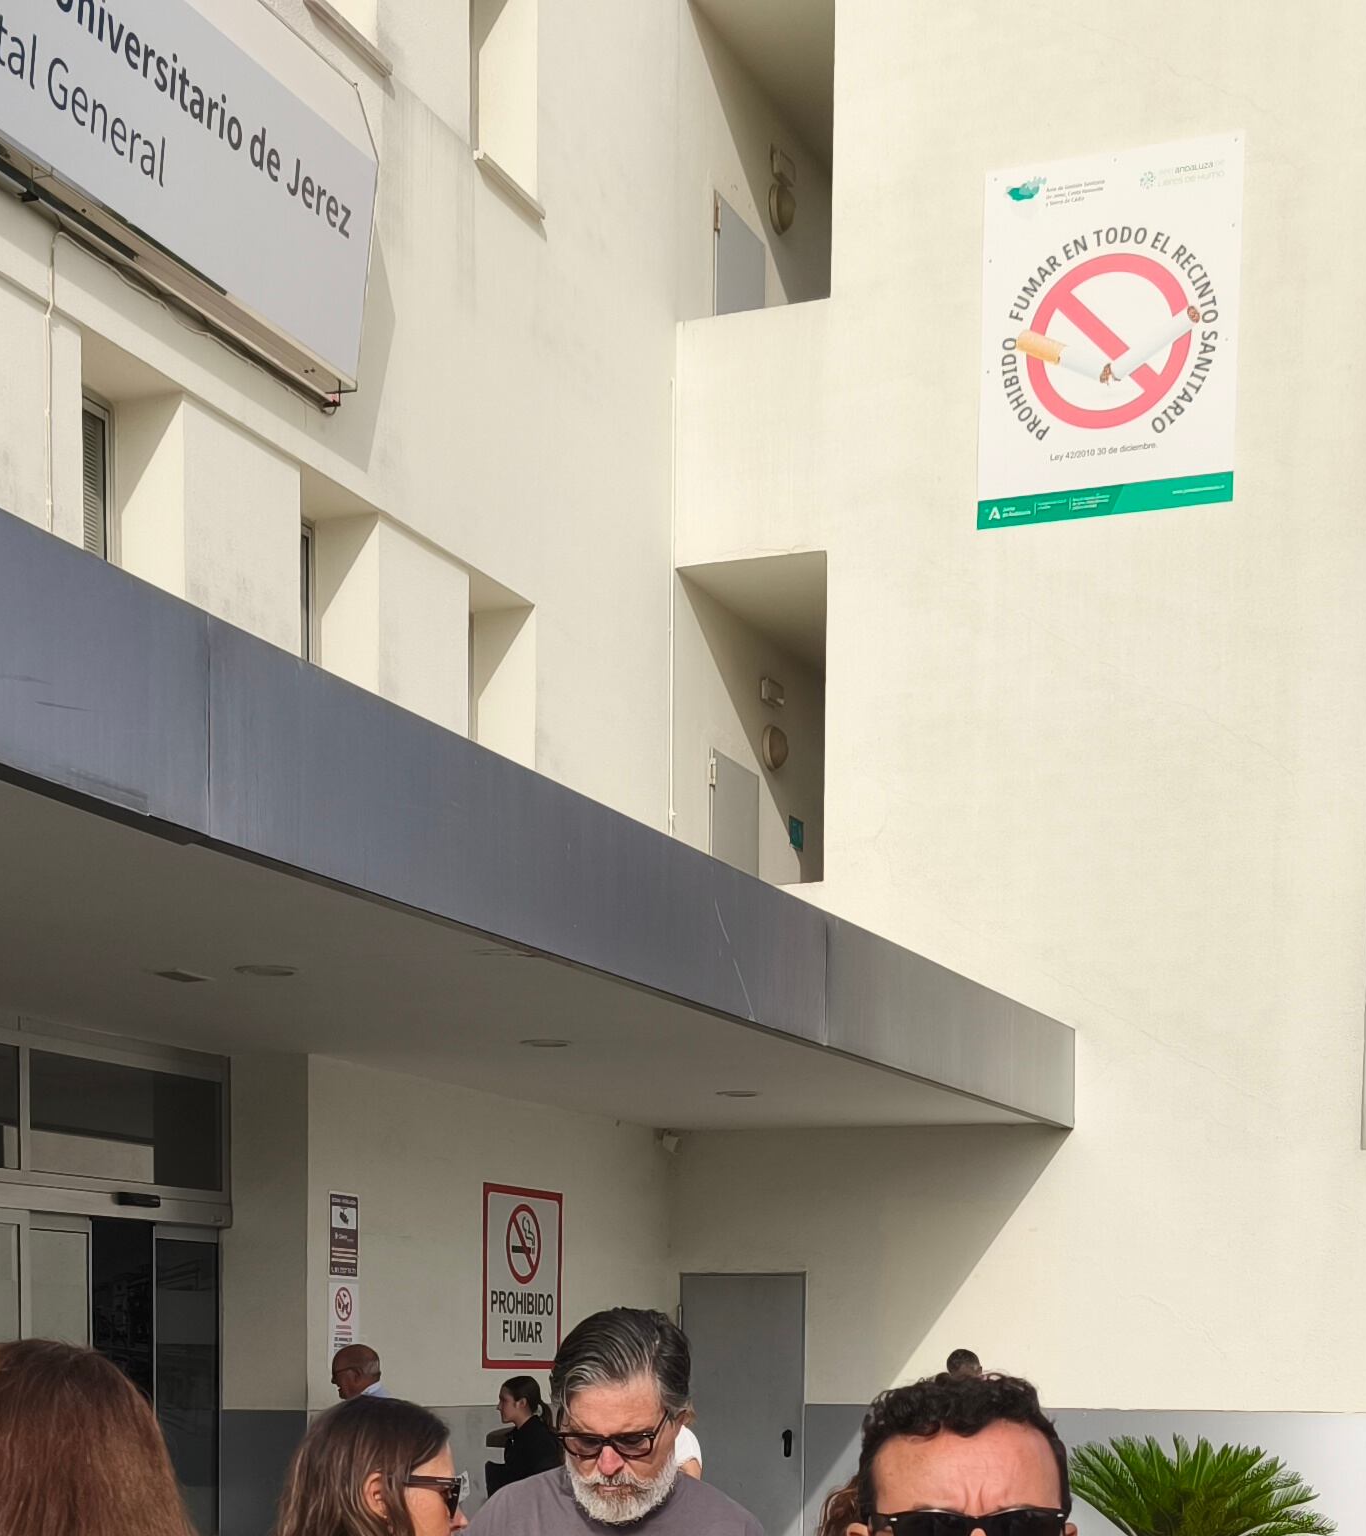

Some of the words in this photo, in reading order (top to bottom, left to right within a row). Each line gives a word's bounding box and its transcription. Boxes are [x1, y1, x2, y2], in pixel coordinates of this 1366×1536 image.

[48, 57, 165, 188] General
[56, 0, 242, 151] niversitario
[250, 127, 281, 183] de
[287, 158, 351, 239] Jerez
[1062, 235, 1089, 261] EN
[1092, 225, 1148, 248] TODO
[1150, 231, 1170, 255] EL
[1009, 255, 1063, 322] FUMAR
[1171, 244, 1219, 324] RECINTO
[1001, 336, 1052, 441] PROHIBIDO
[1151, 330, 1219, 434] SANITARIO
[490, 1290, 554, 1316] PROHIBIDO
[502, 1320, 543, 1343] FUMAR
